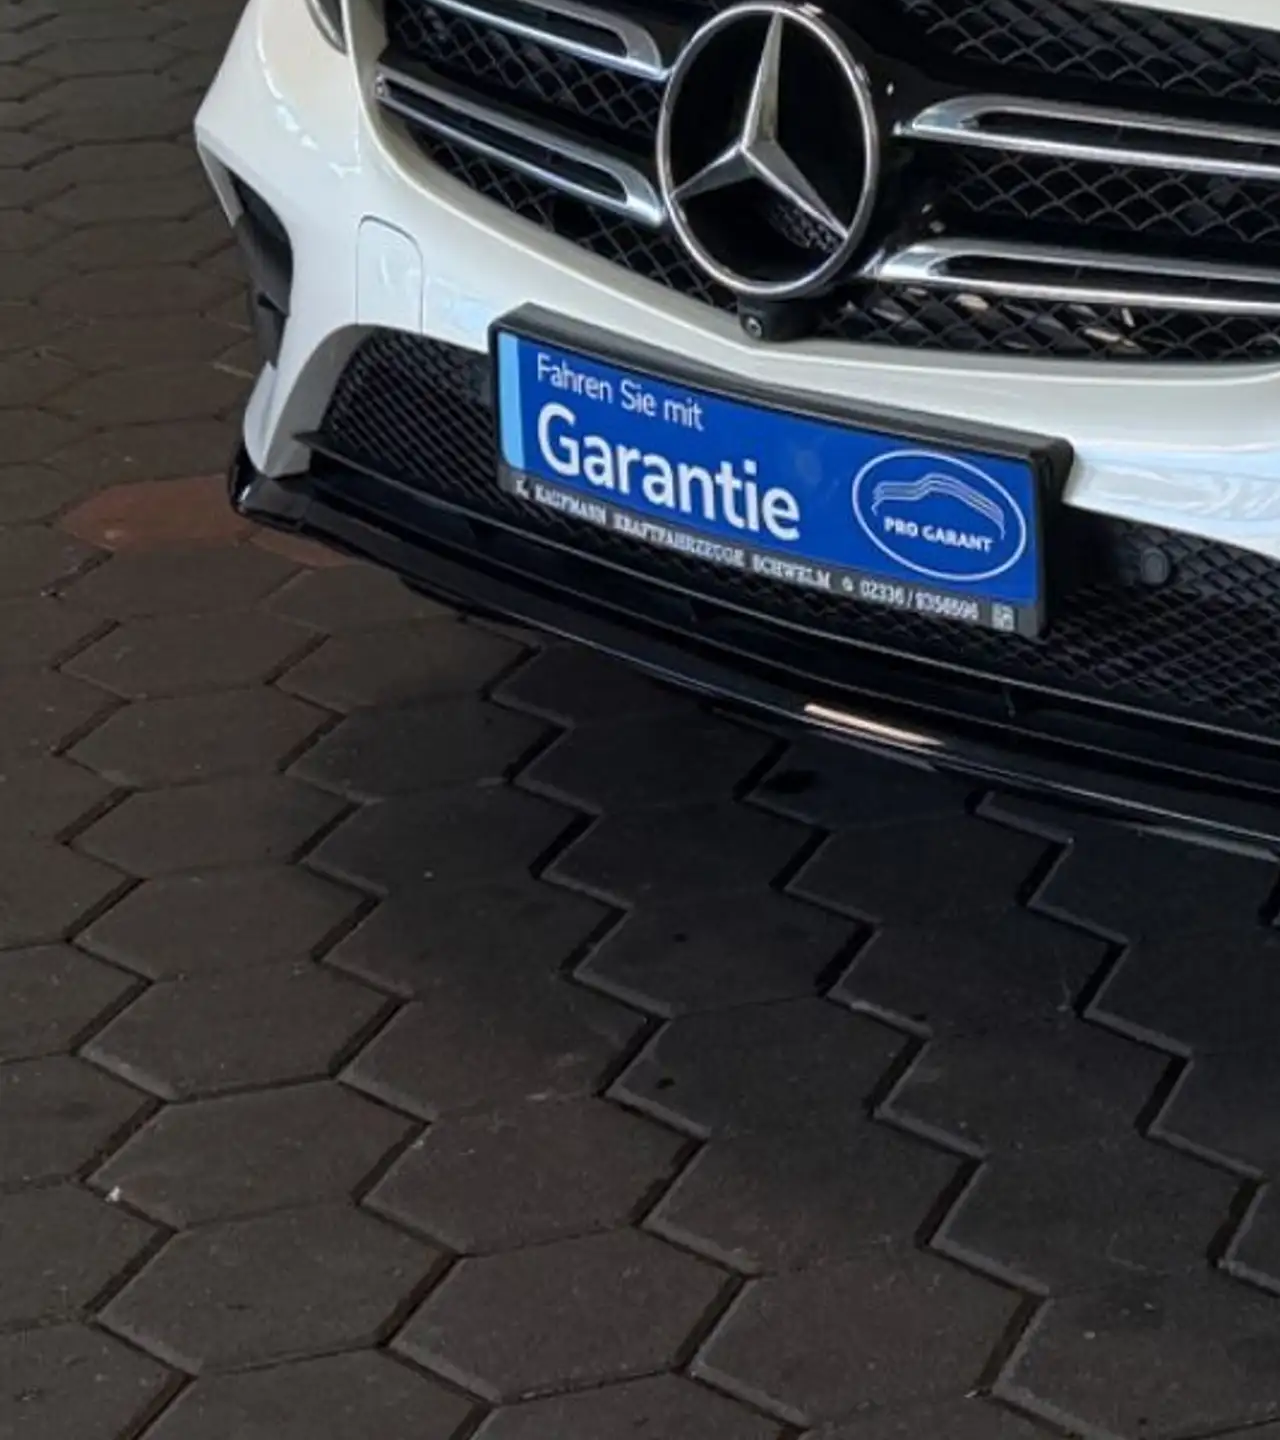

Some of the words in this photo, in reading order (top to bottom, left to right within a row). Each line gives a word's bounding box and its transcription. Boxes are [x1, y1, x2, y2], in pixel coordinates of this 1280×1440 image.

[537, 351, 614, 404] Fahren
[620, 378, 657, 417] Sie
[663, 396, 705, 432] mit
[536, 401, 801, 542] Garantie
[882, 515, 918, 538] PRO
[921, 524, 995, 553] GARANT
